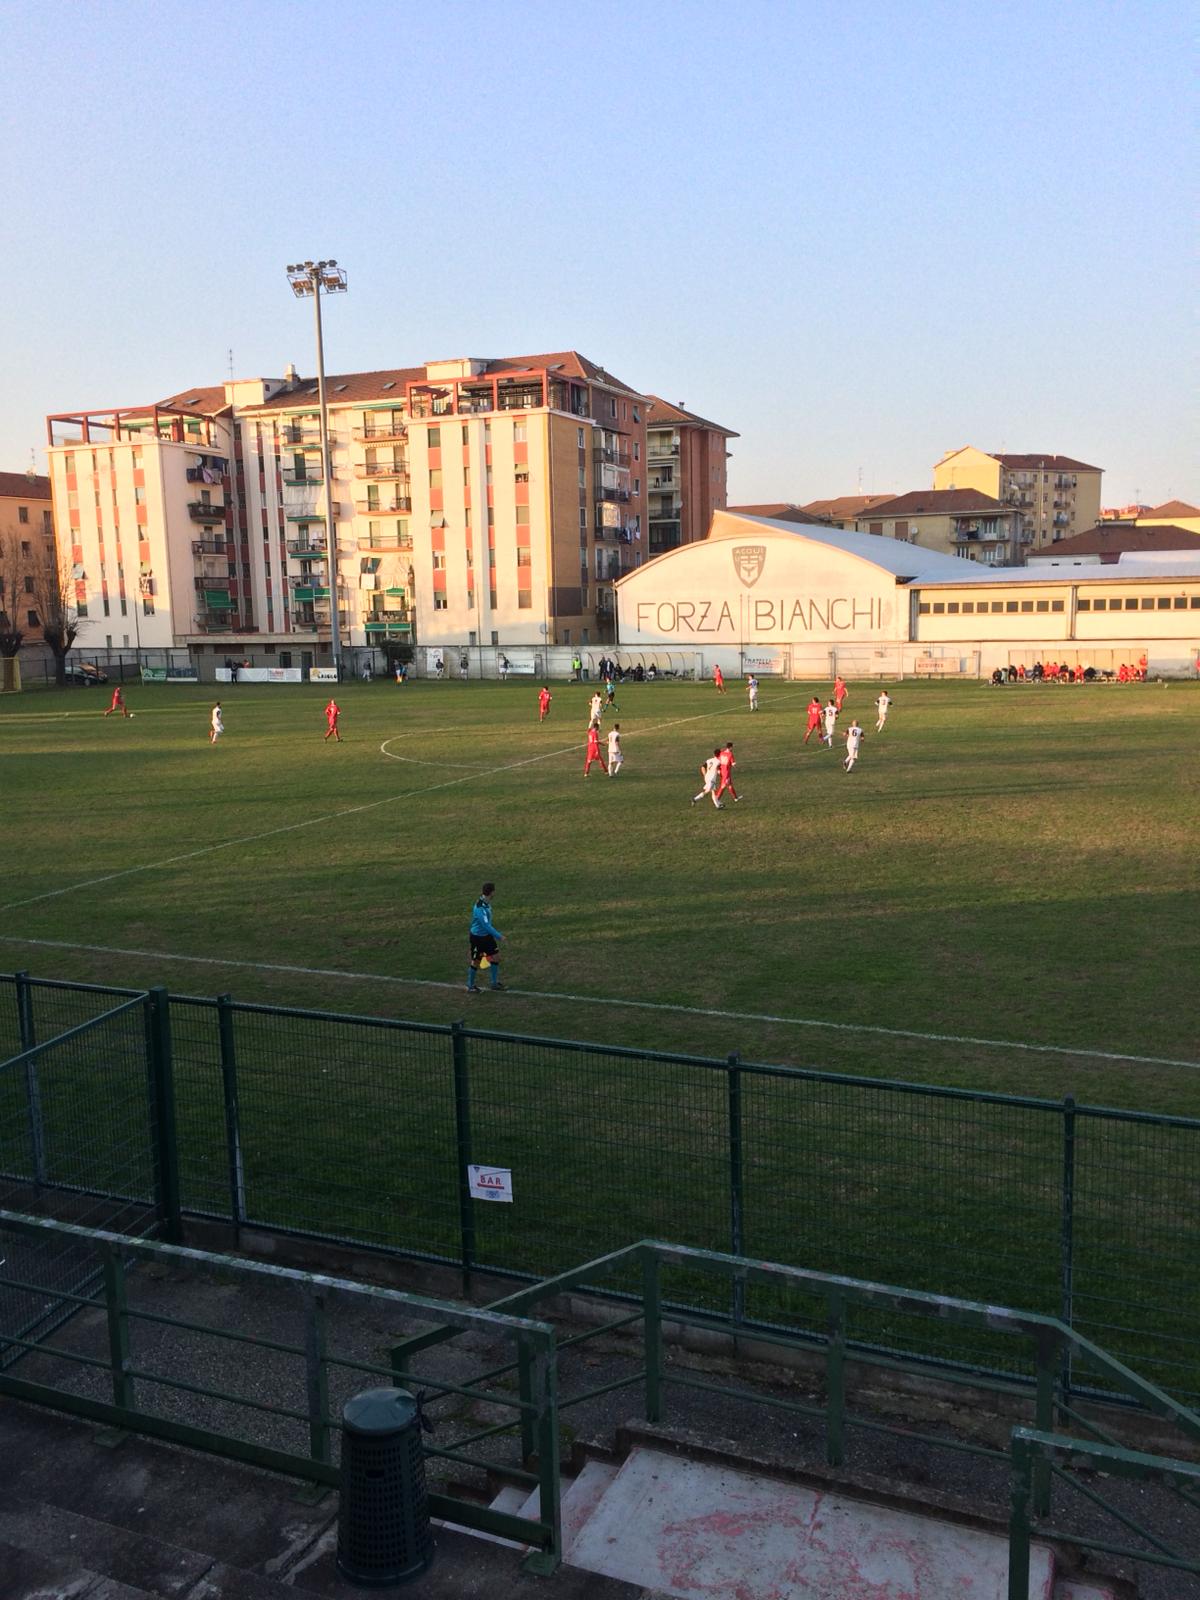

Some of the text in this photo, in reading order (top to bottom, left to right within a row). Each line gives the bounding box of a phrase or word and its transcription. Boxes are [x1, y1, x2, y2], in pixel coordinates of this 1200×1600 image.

[637, 598, 882, 632] FORZA BIANCHI
[852, 728, 858, 737] 6
[480, 1175, 501, 1185] BAR
